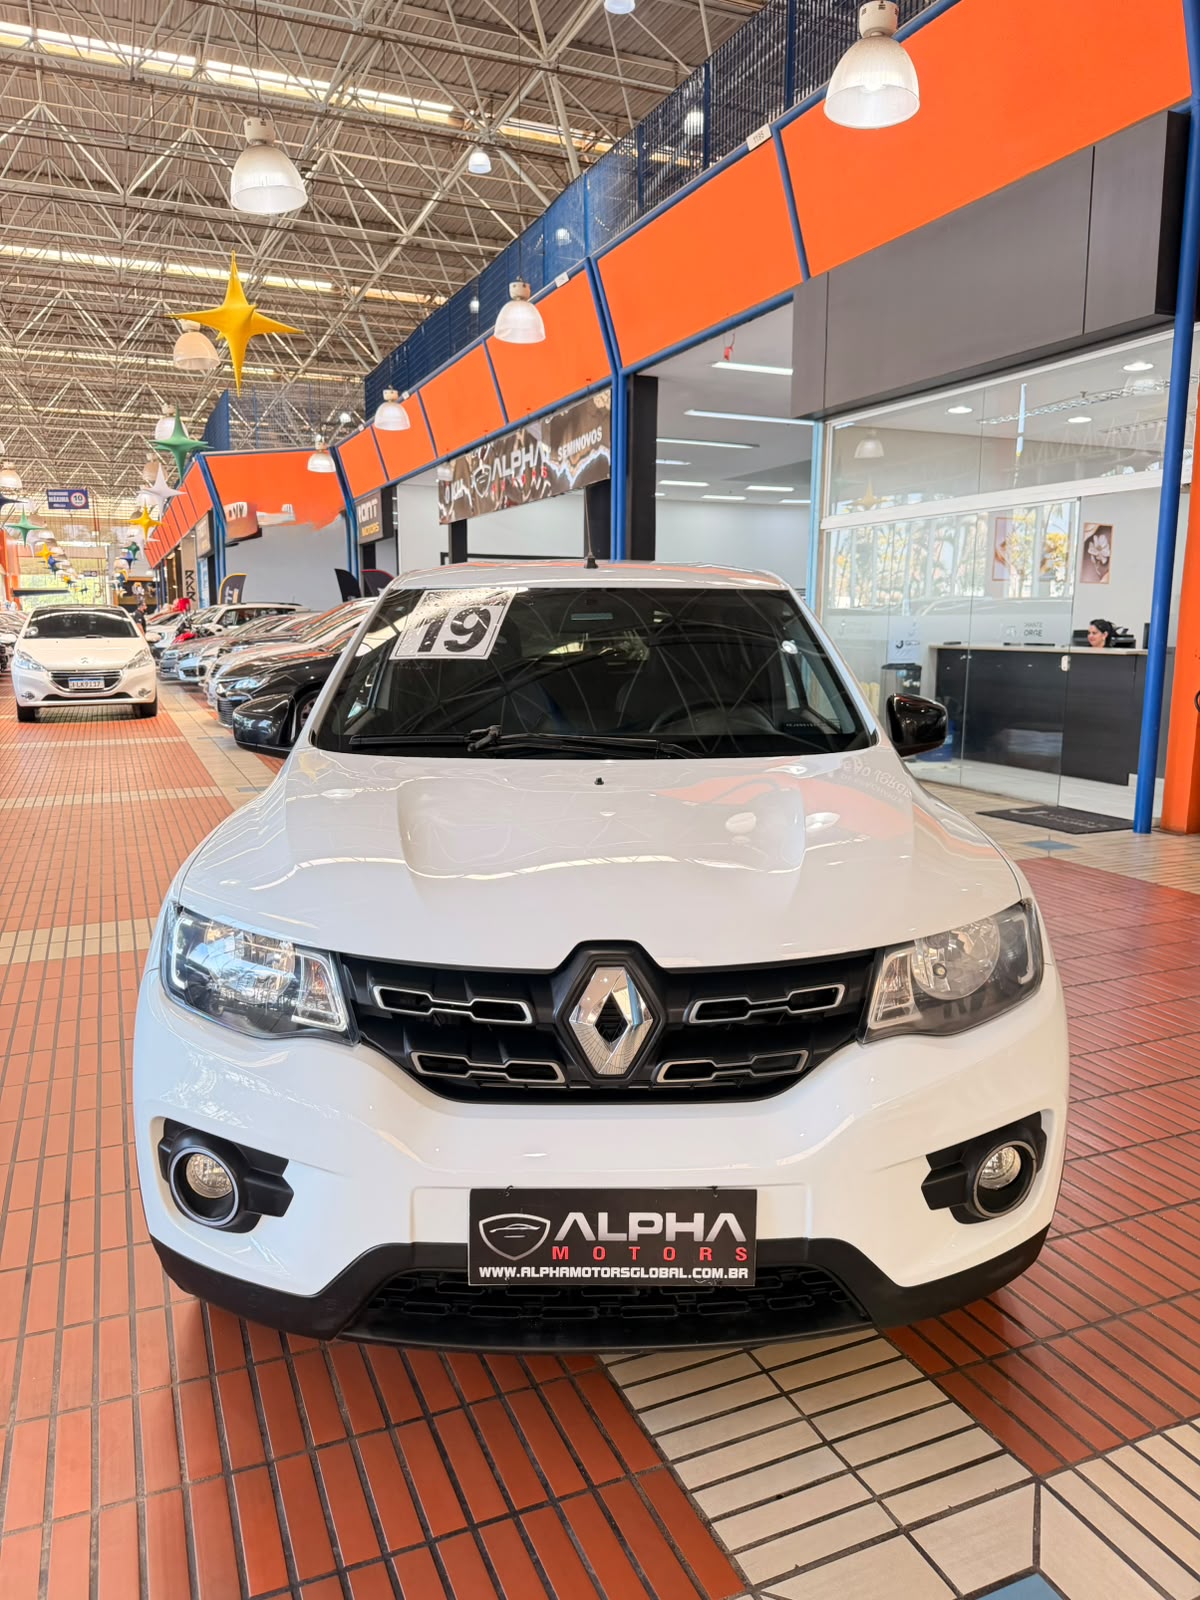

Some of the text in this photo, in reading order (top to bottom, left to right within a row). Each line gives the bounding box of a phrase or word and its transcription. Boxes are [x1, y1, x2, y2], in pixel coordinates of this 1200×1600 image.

[557, 426, 602, 461] SEMINOVOS
[491, 441, 547, 481] ALPHA
[415, 606, 492, 653] 19
[553, 1211, 748, 1242] ALPHA
[551, 1246, 749, 1262] MOTORS
[478, 1265, 750, 1279] WWW.ALPHAMOTORSGLOBAL.COM.BR
